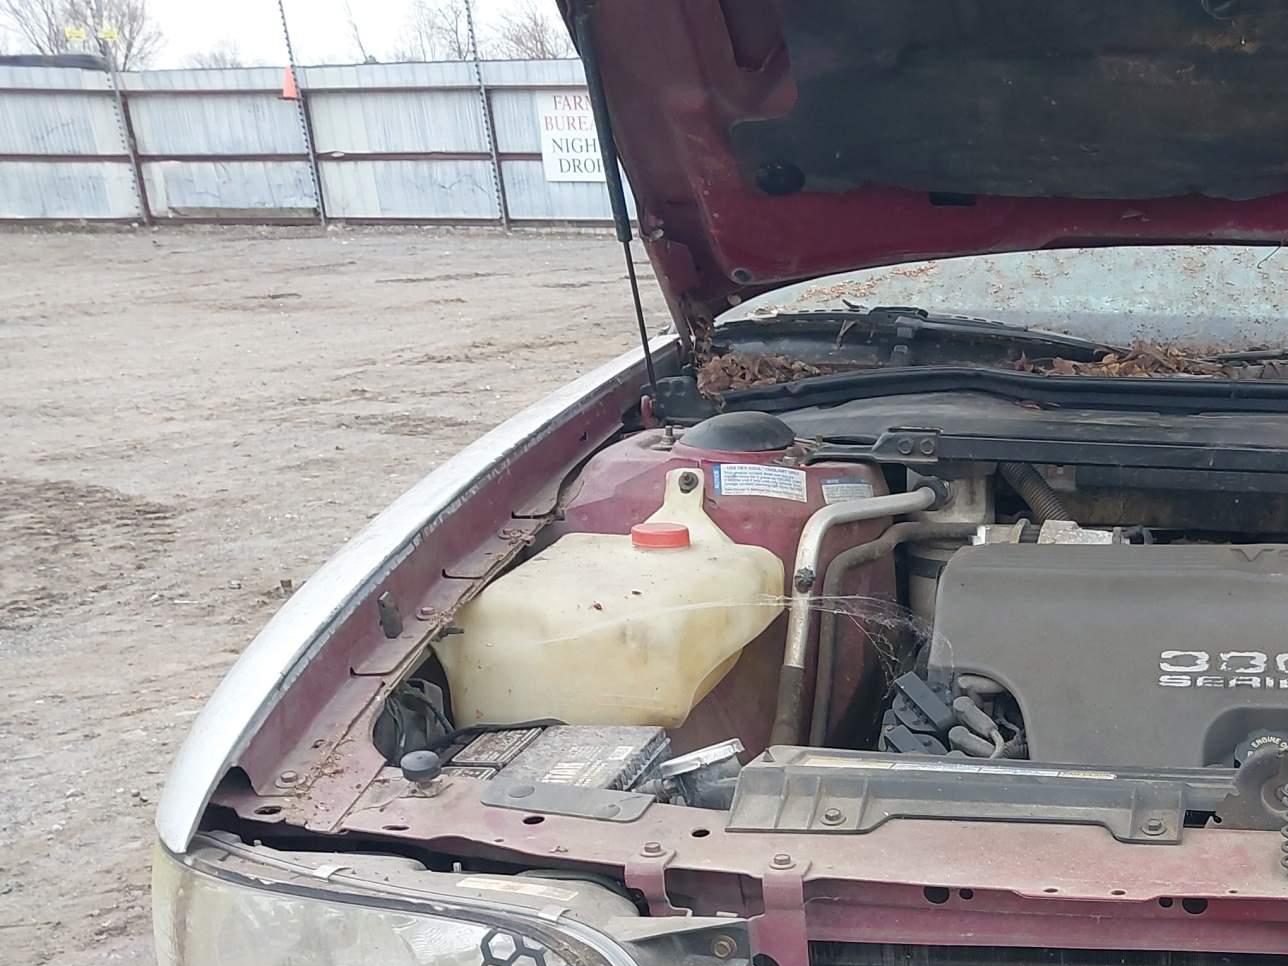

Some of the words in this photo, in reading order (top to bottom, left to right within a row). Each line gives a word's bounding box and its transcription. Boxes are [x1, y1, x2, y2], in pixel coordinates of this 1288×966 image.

[544, 115, 593, 131] BURE
[552, 137, 597, 154] NIGH
[1250, 735, 1282, 749] ENGINE
